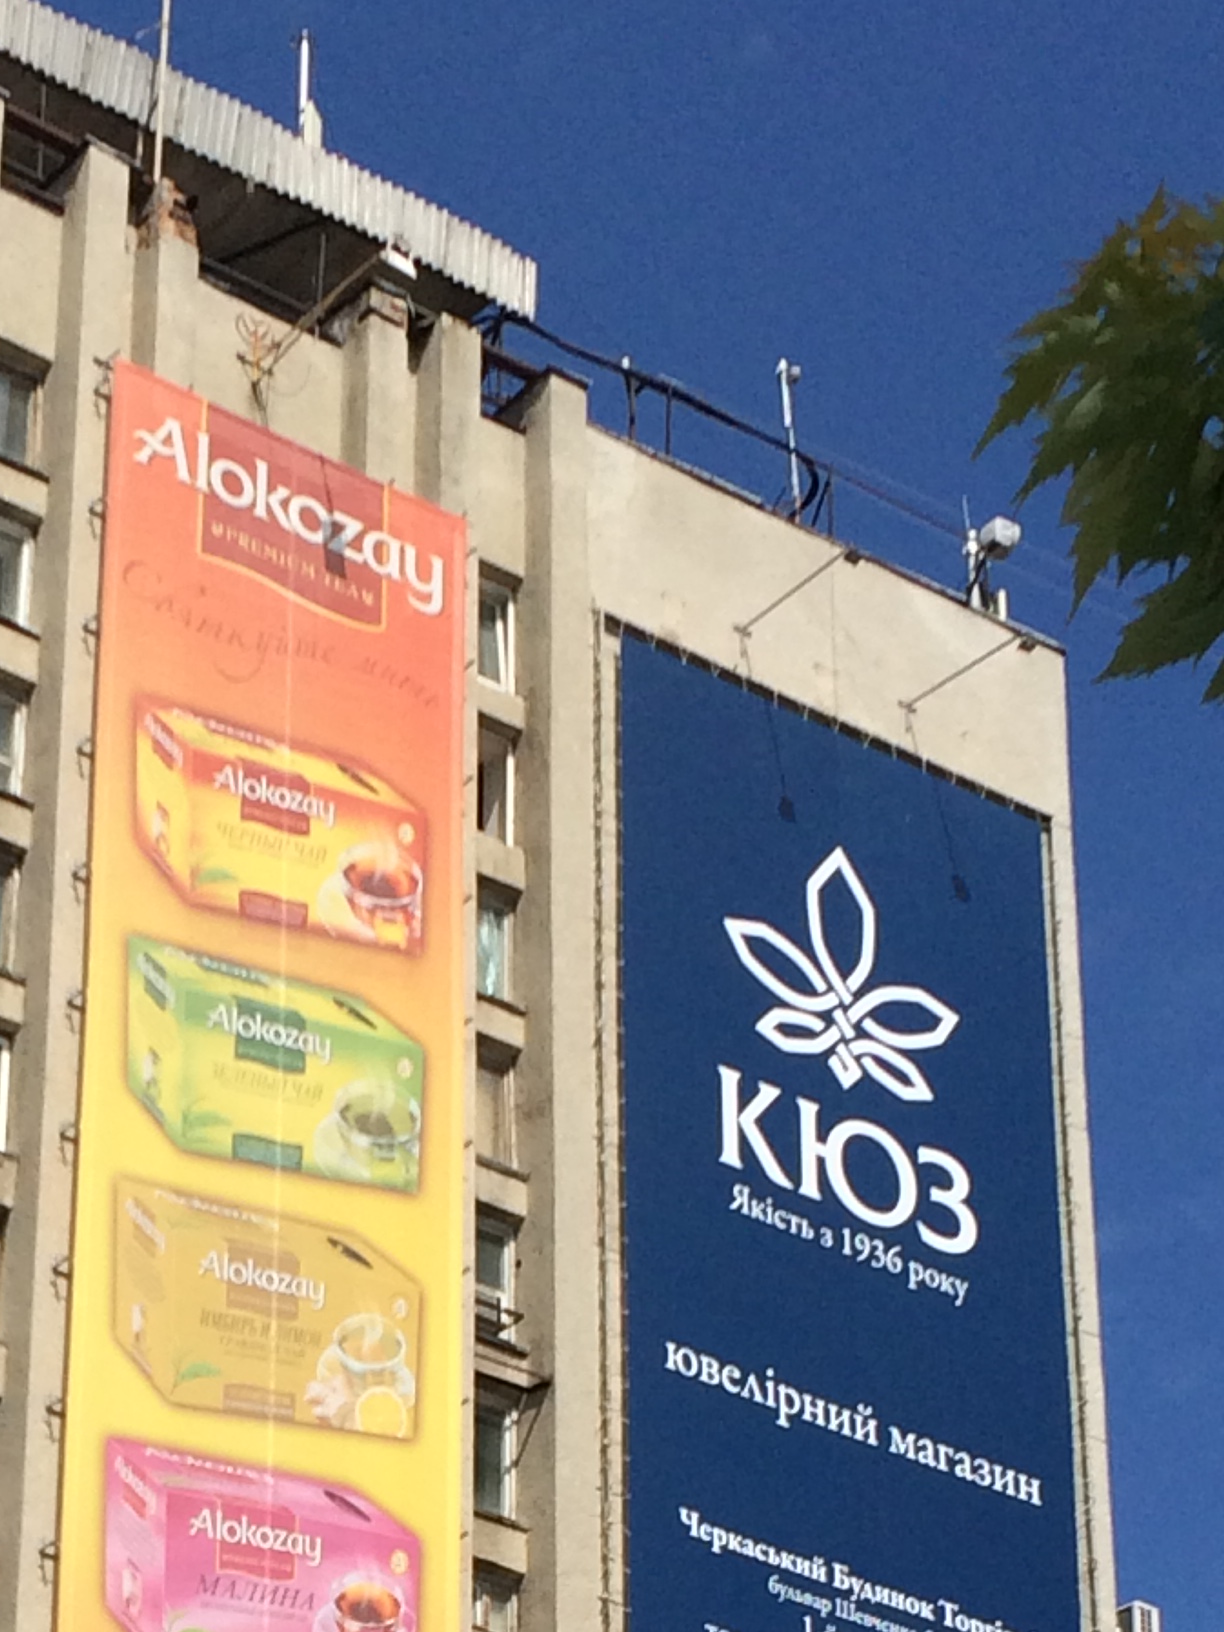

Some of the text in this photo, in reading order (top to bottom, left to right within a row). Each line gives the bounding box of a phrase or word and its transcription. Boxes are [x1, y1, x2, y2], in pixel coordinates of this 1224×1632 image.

[133, 417, 445, 617] Alokozay
[213, 764, 335, 828] Alokozay
[208, 1004, 331, 1065] Alokozay
[717, 1064, 978, 1255] КЮЗ
[730, 1184, 968, 1305] Якість з 1936 року
[199, 1250, 325, 1310] Alokozay
[665, 1340, 1042, 1506] ювелірний магазин
[189, 1508, 322, 1567] Alokozay
[678, 1506, 826, 1584] Черкаський
[832, 1562, 935, 1621] Будинок
[196, 1574, 315, 1611] МАЛИНА
[768, 1575, 832, 1617] бульвар
